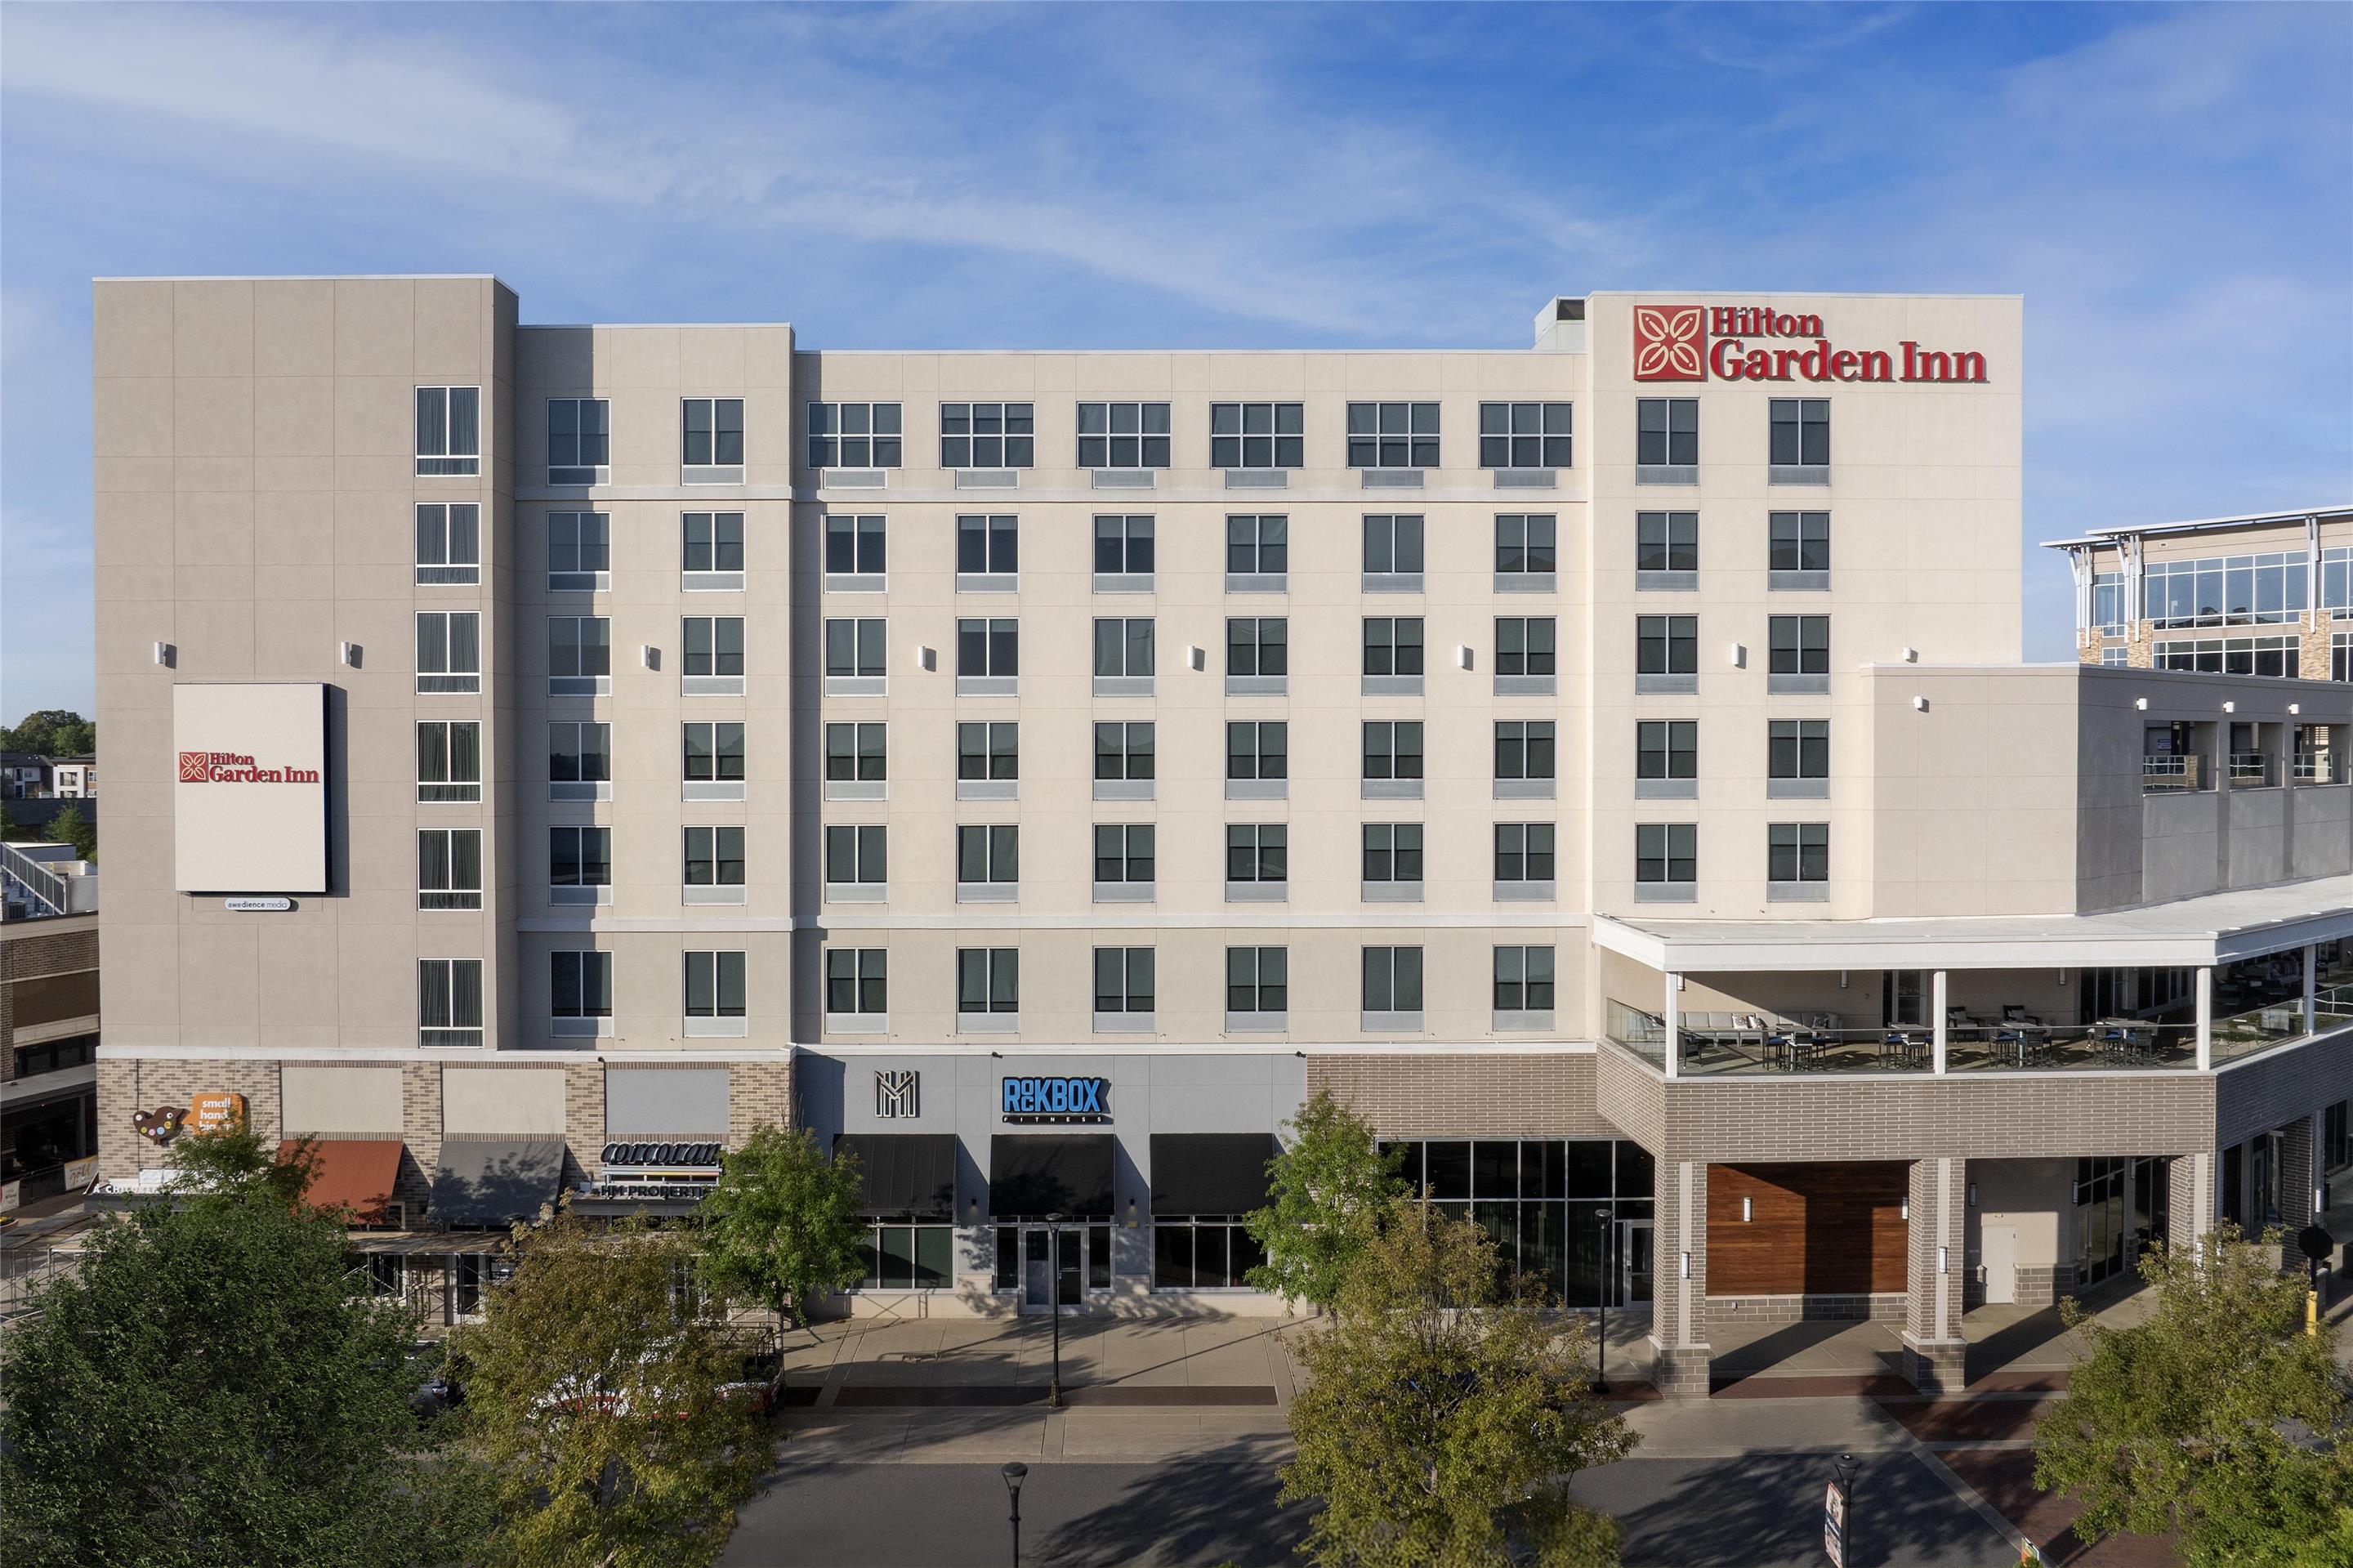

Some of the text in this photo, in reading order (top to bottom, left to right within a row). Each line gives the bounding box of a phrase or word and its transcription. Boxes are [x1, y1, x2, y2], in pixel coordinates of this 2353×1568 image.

[1710, 306, 1823, 336] Hilton
[1709, 338, 1987, 382] Garden Inn
[209, 753, 255, 766] Hilton
[209, 766, 319, 783] Garden Inn
[202, 1097, 231, 1108] small
[1003, 1079, 1101, 1113] ROCKBOX
[199, 1109, 233, 1119] hand
[601, 1143, 721, 1164] corcoran
[92, 1183, 100, 1194] A
[627, 1186, 716, 1197] PROPERTI
